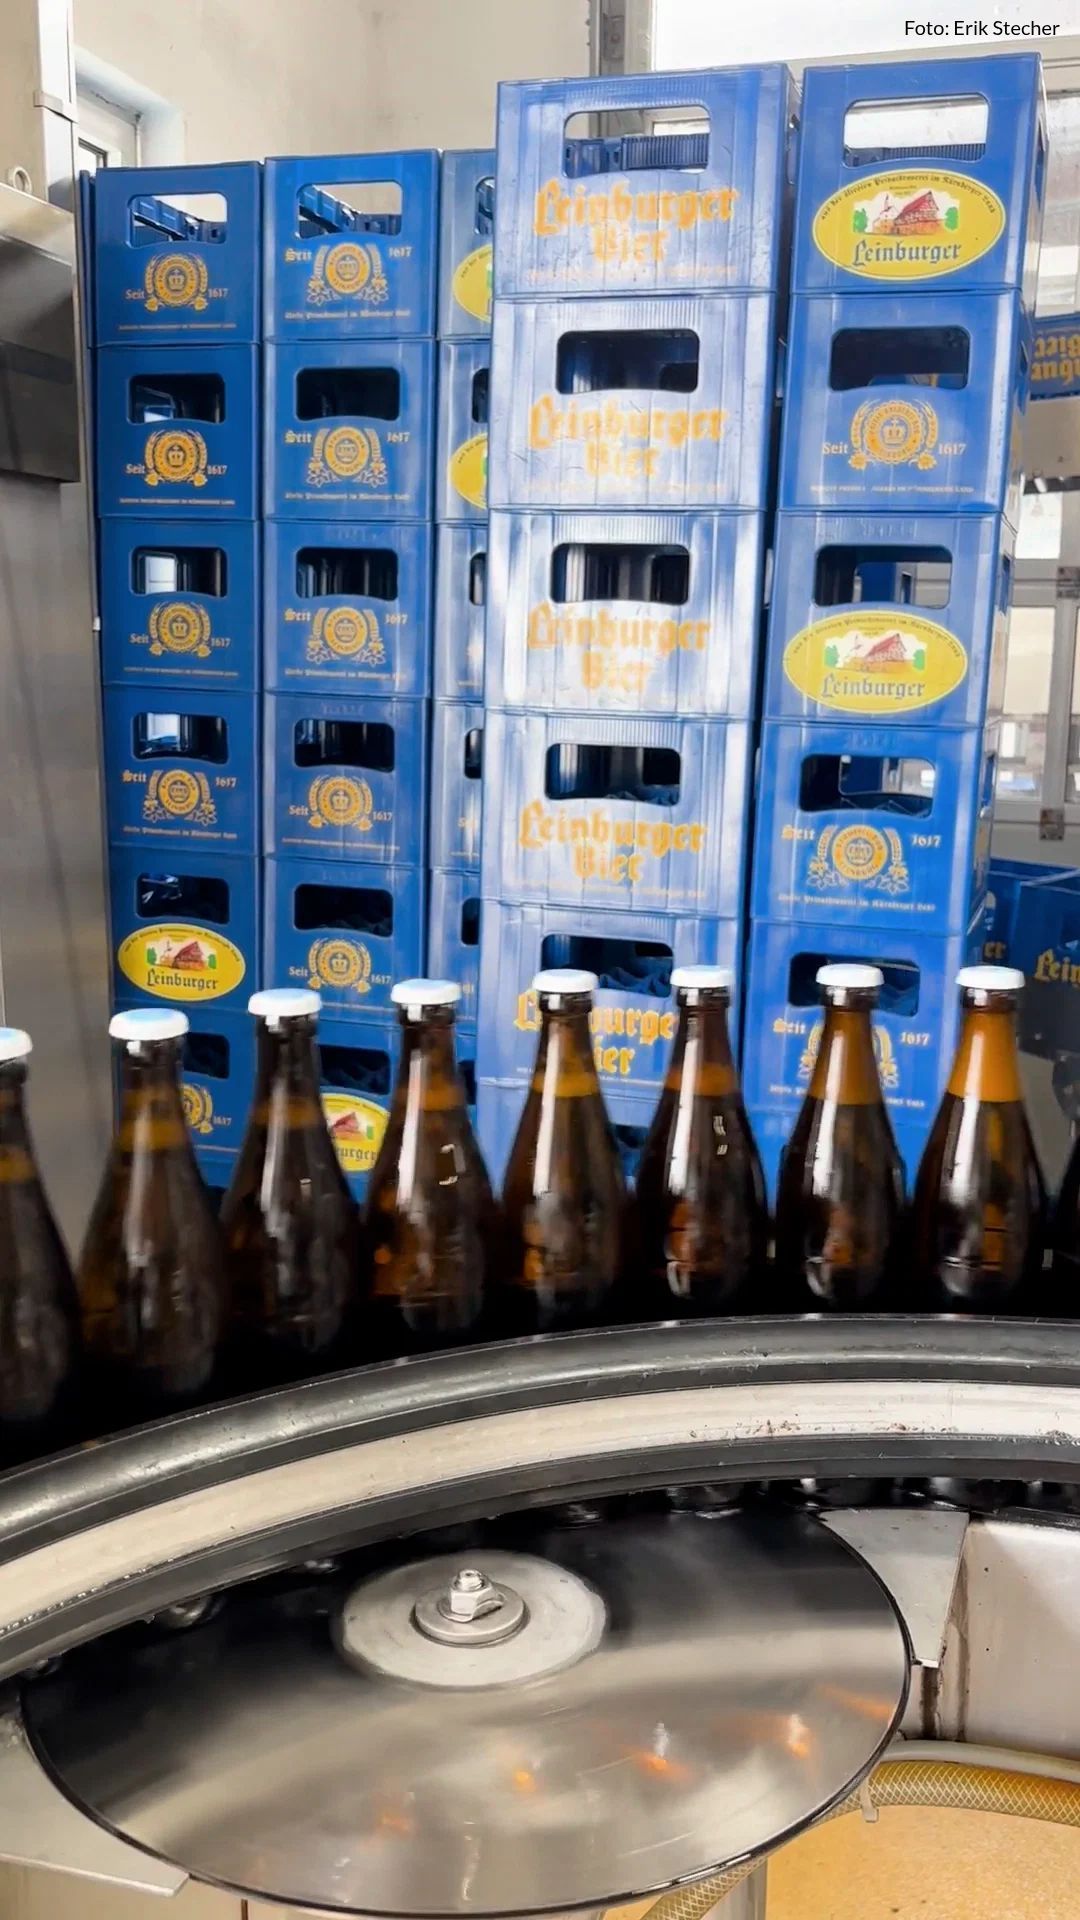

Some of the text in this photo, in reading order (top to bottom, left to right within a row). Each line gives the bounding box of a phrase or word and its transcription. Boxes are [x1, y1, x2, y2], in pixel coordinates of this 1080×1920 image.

[533, 177, 741, 236] Leinburger
[592, 226, 669, 263] Bier
[852, 239, 962, 268] Leinburger
[125, 288, 229, 300] Seit 1617
[529, 393, 727, 450] Leinburger
[822, 441, 967, 455] Seit 1617
[126, 463, 228, 476] Seit 1617
[130, 633, 230, 648] Seit 1617
[821, 672, 926, 700] Leinburger
[289, 805, 393, 822] Seit 1617
[519, 799, 708, 858] Leinburger
[147, 967, 220, 991] Leinburger
[289, 966, 392, 985] Seit 1617
